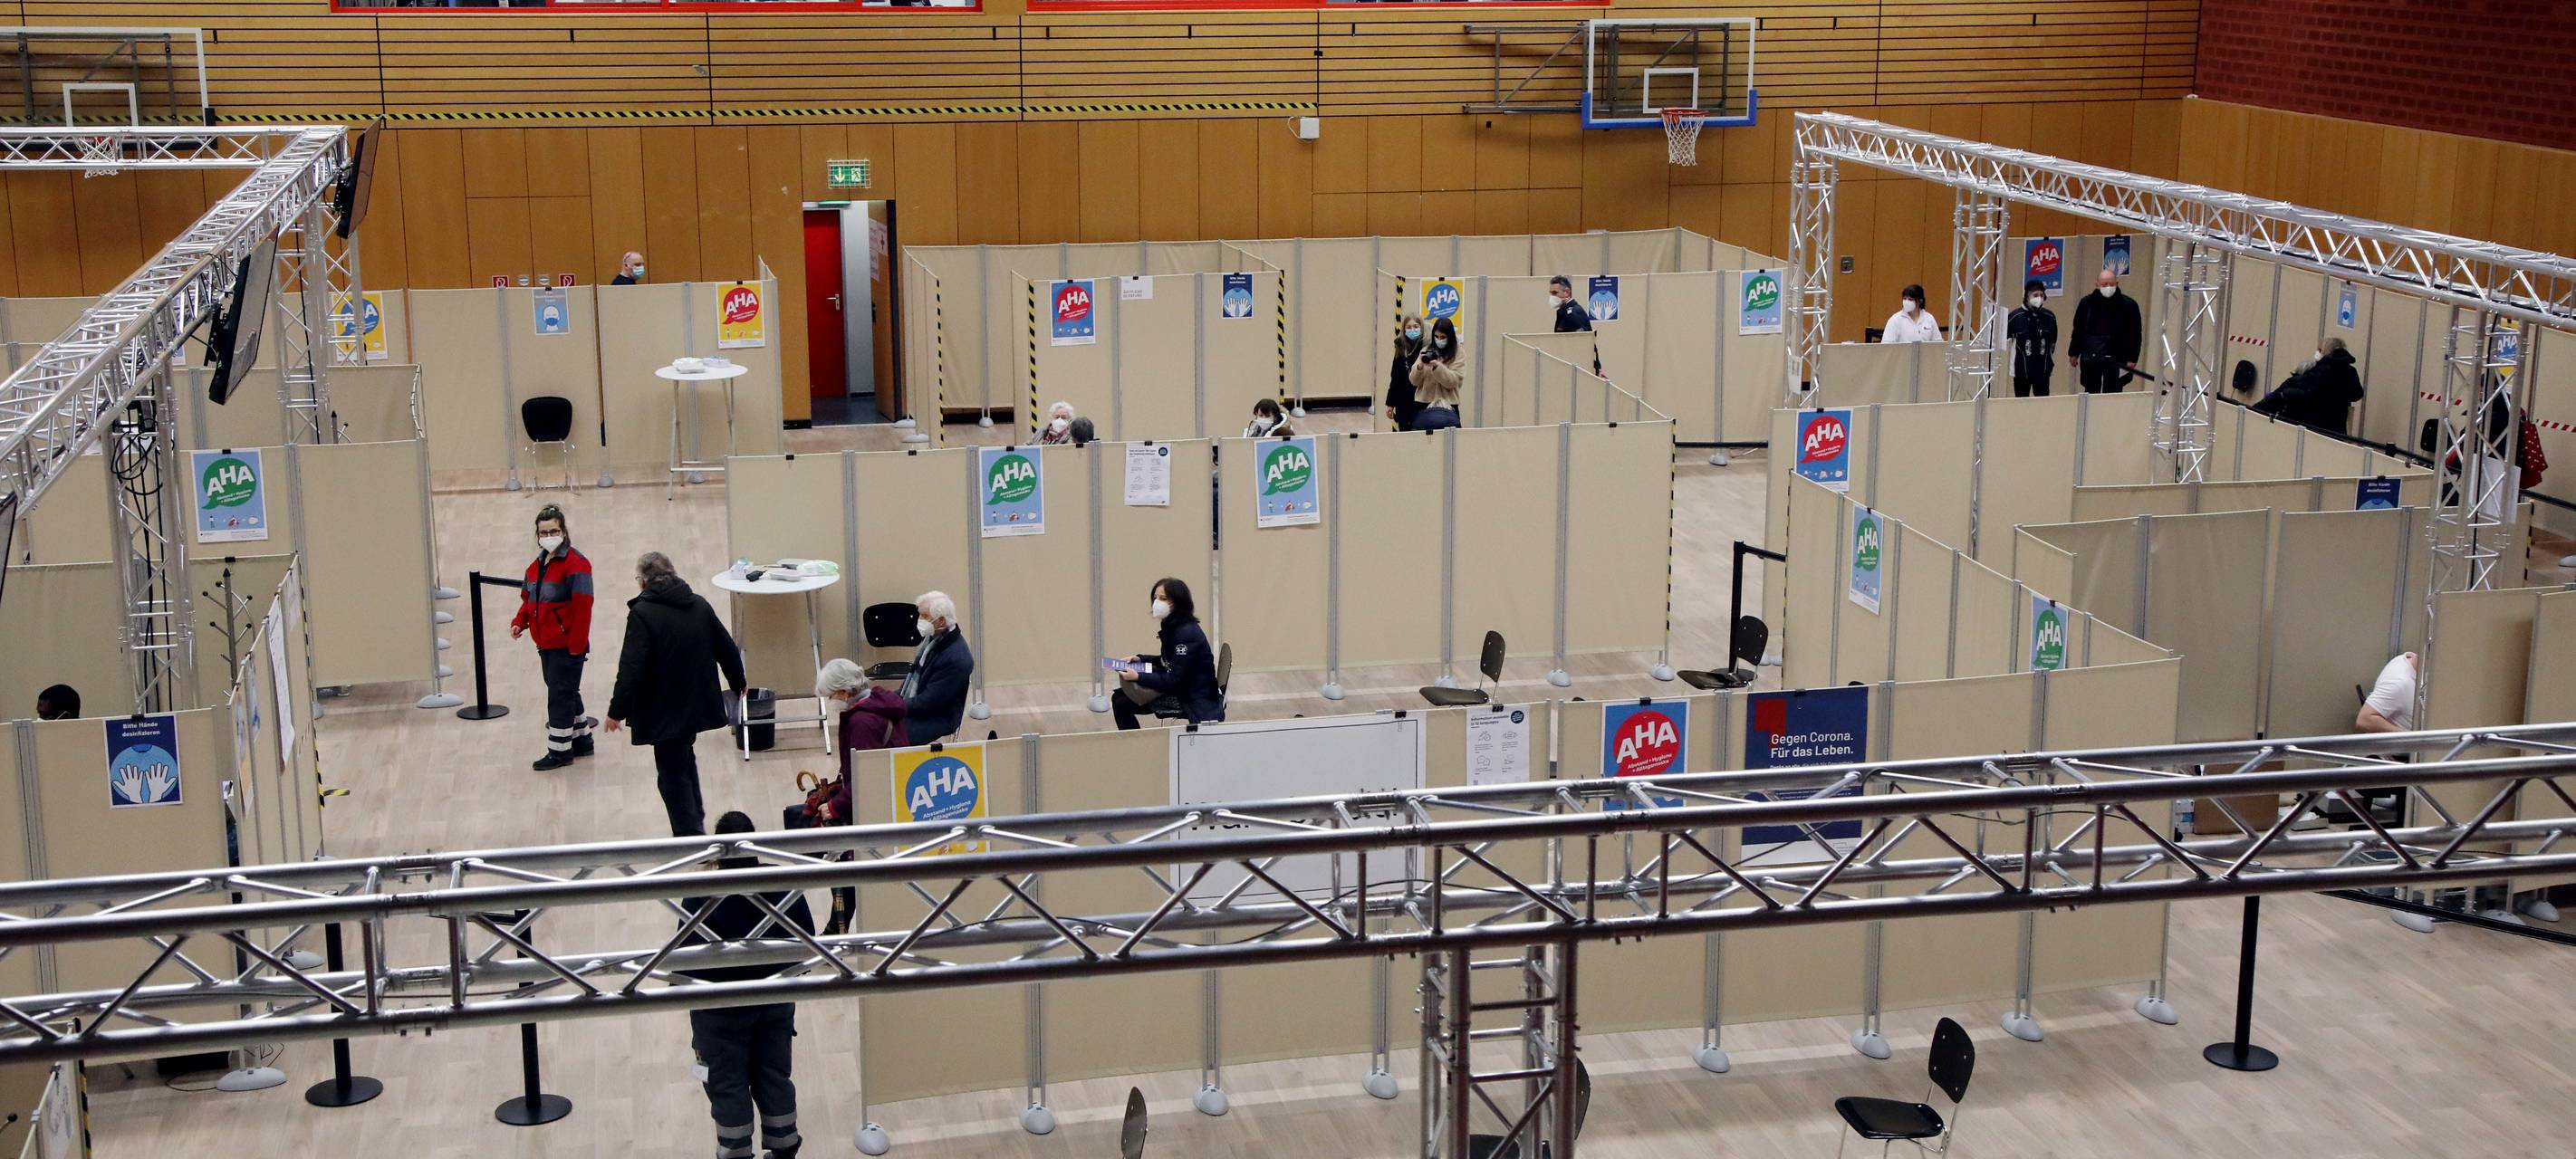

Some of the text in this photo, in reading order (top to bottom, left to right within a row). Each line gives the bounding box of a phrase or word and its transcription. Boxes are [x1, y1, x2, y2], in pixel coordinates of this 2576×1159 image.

[2031, 247, 2059, 268] AHA
[1058, 291, 1089, 313] AHA
[1428, 289, 1459, 311] AHA
[1747, 281, 1777, 302] AHA
[726, 292, 757, 315] AHA
[2497, 335, 2518, 353] AHA
[1805, 423, 1844, 452] AHA
[991, 462, 1035, 493] AHA
[1266, 452, 1310, 484] AHA
[207, 465, 255, 497] AHA
[1857, 527, 1879, 554] AHA
[2036, 620, 2062, 651] AHA
[1616, 721, 1677, 764] AHA
[1771, 732, 1854, 747] Gegen Corona.
[1770, 744, 1854, 759] Für das Leben.
[909, 766, 976, 814] AHA
[923, 806, 946, 819] Abstand
[948, 800, 971, 813] Hygiene
